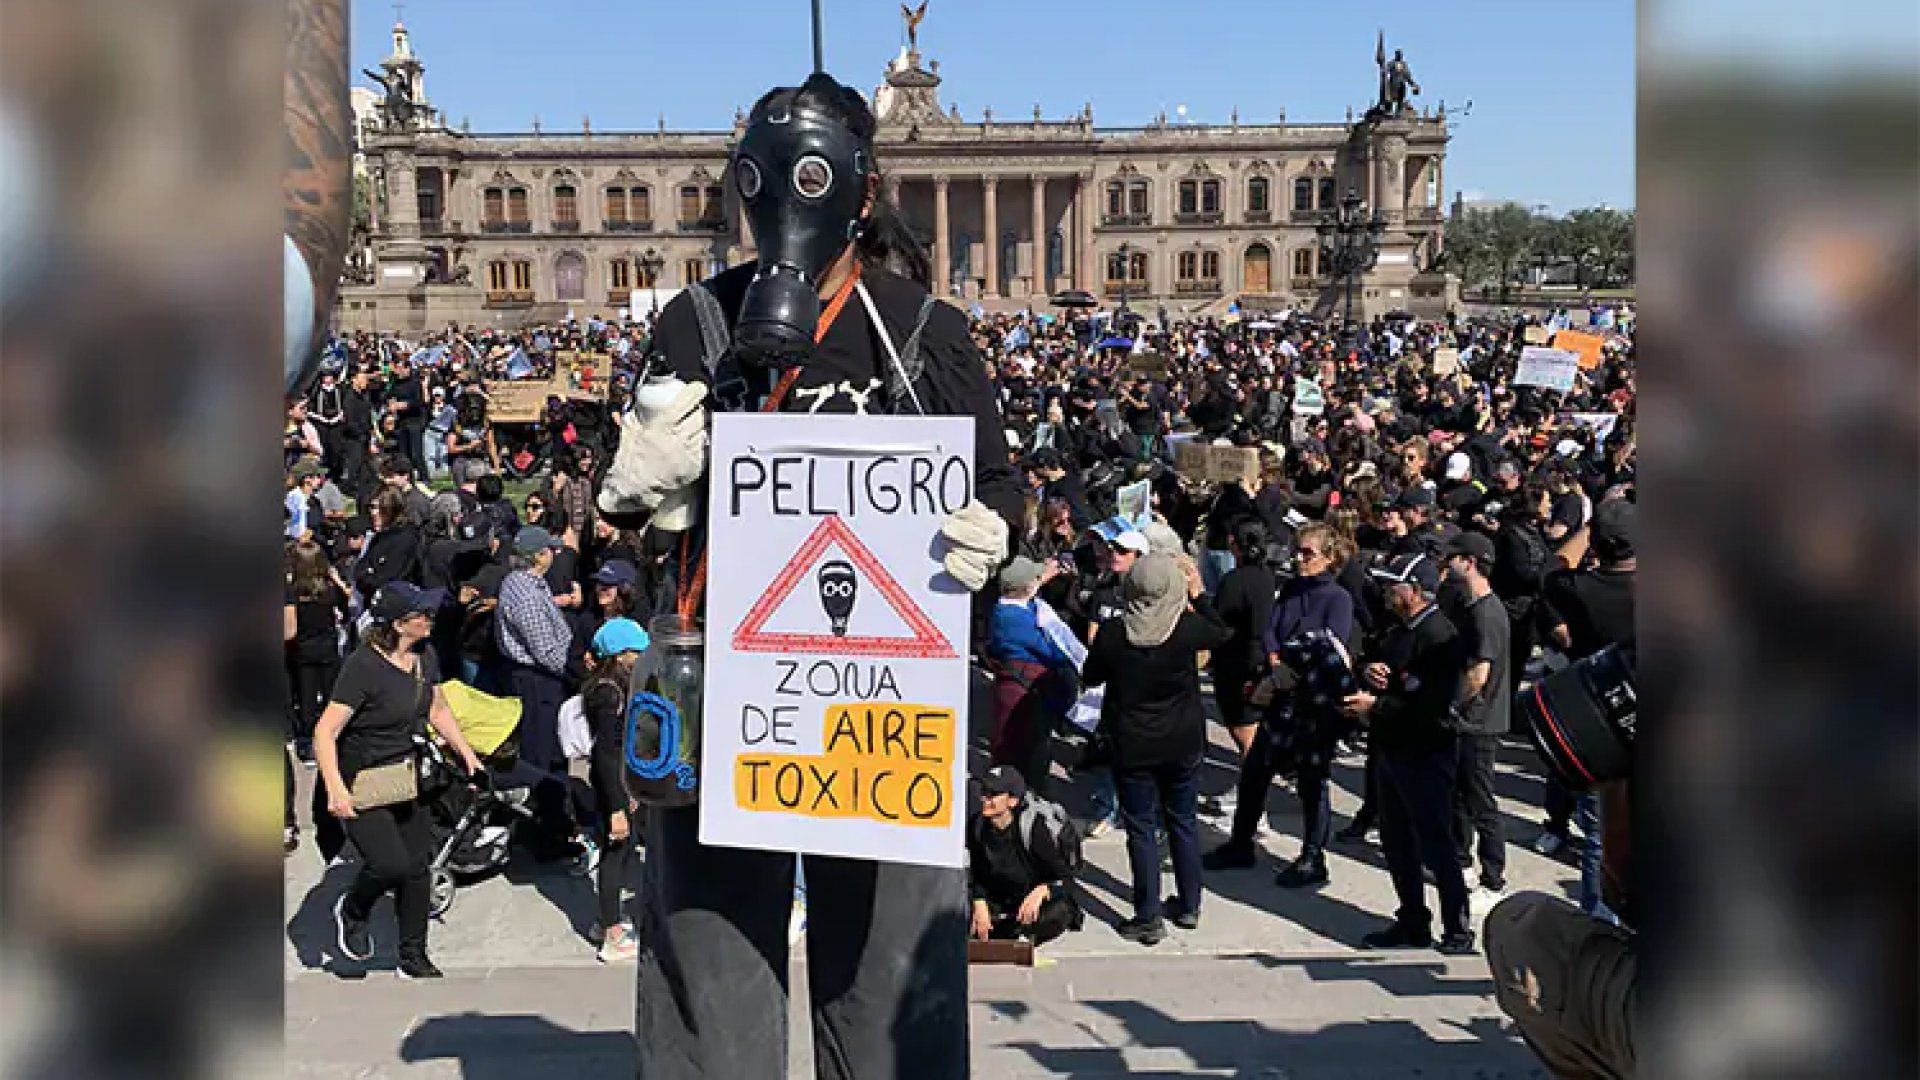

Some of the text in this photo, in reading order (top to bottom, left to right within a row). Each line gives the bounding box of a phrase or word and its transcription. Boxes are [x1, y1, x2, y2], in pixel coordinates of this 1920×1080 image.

[730, 455, 970, 518] PELIGRO
[775, 660, 902, 700] ZONA
[740, 704, 949, 762] DE AIRE
[741, 760, 942, 820] TOXICO
